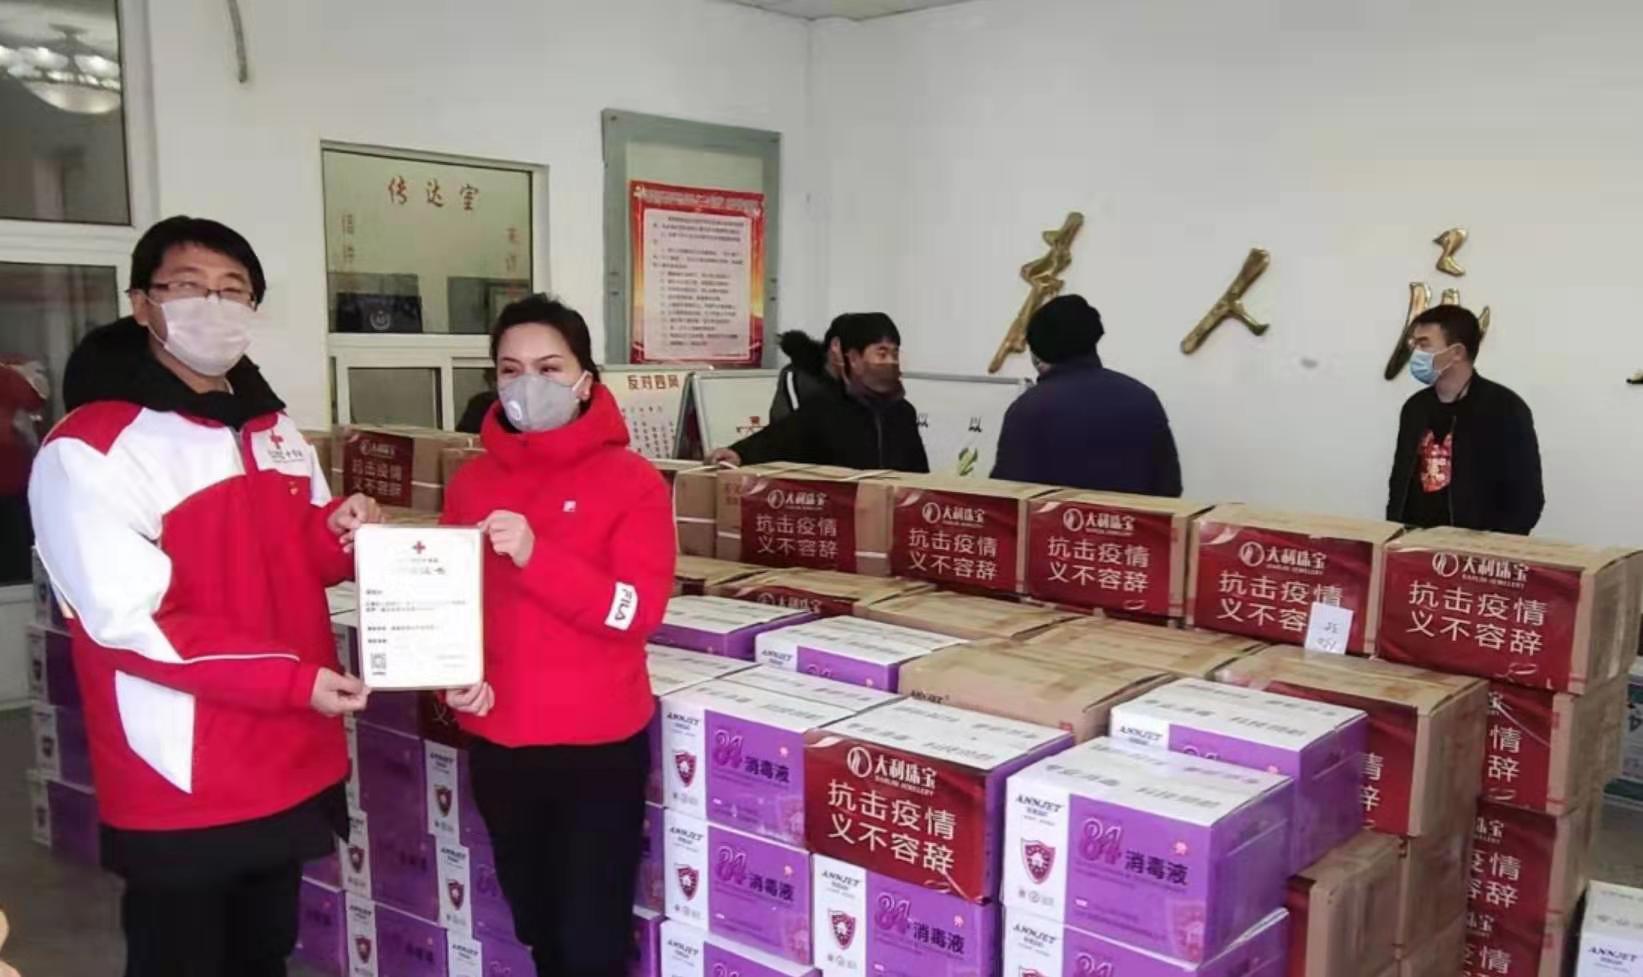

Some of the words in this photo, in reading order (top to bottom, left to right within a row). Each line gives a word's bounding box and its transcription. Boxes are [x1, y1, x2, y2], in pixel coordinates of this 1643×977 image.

[387, 175, 480, 212] 传达室
[627, 373, 680, 391] 反对四风
[755, 512, 838, 538] 抗击疫情
[755, 534, 839, 561] 义不容辞
[907, 528, 998, 559] 抗击疫情
[1047, 535, 1150, 569] 抗击疫情
[1266, 545, 1328, 570] 大利珠宝
[907, 550, 998, 581] 义不容辞
[1047, 560, 1150, 593] 义不容辞
[1463, 556, 1529, 583] 大利珠宝
[1218, 569, 1343, 607] 抗击疫情
[1407, 579, 1548, 627] 抗击疫情
[614, 588, 633, 621] FILA
[1216, 597, 1308, 632] 义不容
[1405, 609, 1544, 657] 义不容辞
[1118, 725, 1164, 742] ANNJET
[874, 753, 937, 790] 大利珠宝
[827, 777, 957, 841] 抗击疫情
[1016, 794, 1065, 813] ANNJET
[827, 812, 956, 875] 义不容辞
[821, 870, 860, 888] ANNJET
[1124, 849, 1189, 887] 消毒液
[748, 872, 795, 903] 消毒液
[912, 921, 967, 955] 消毒液
[1013, 923, 1057, 945] ANNJET
[1587, 946, 1639, 963] ANNJET
